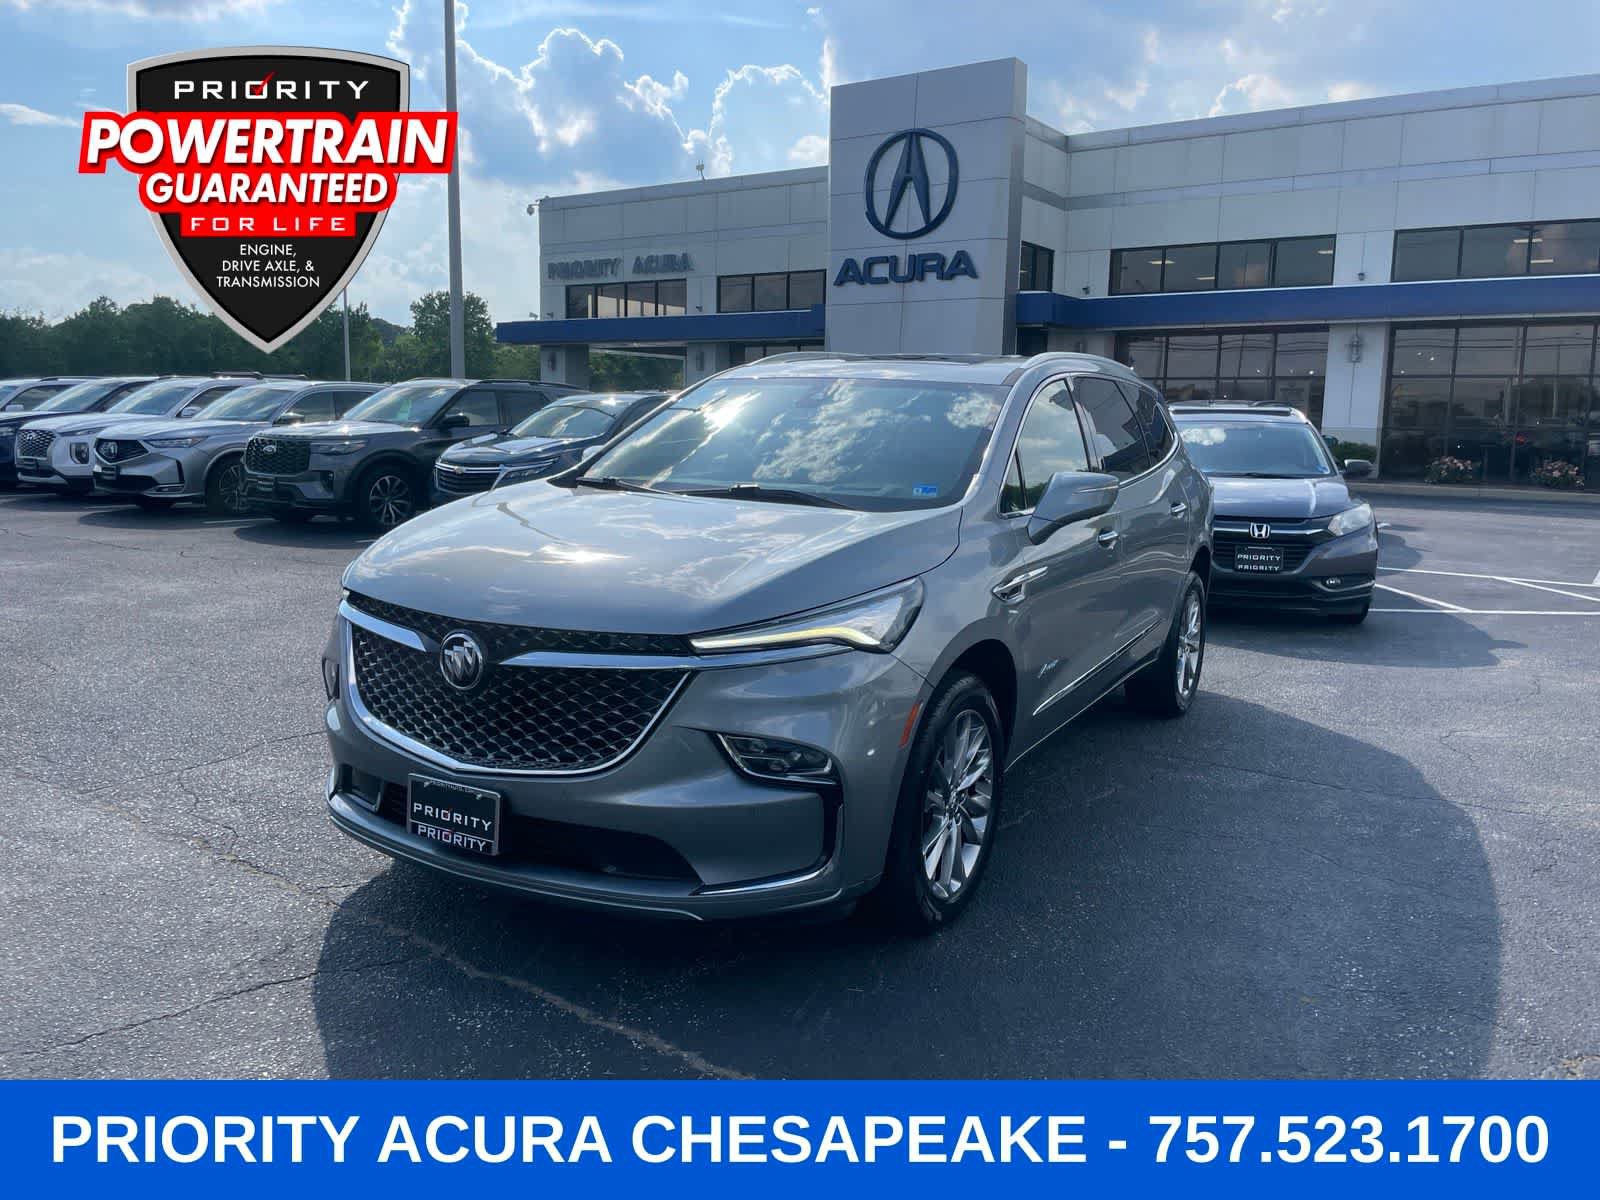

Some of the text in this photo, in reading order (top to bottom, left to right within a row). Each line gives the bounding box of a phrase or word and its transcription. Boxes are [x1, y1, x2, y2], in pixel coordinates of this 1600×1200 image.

[632, 252, 695, 274] ACURA
[833, 250, 979, 286] ACURA
[413, 802, 492, 831] PRIORITY
[417, 825, 487, 851] PRIORITY
